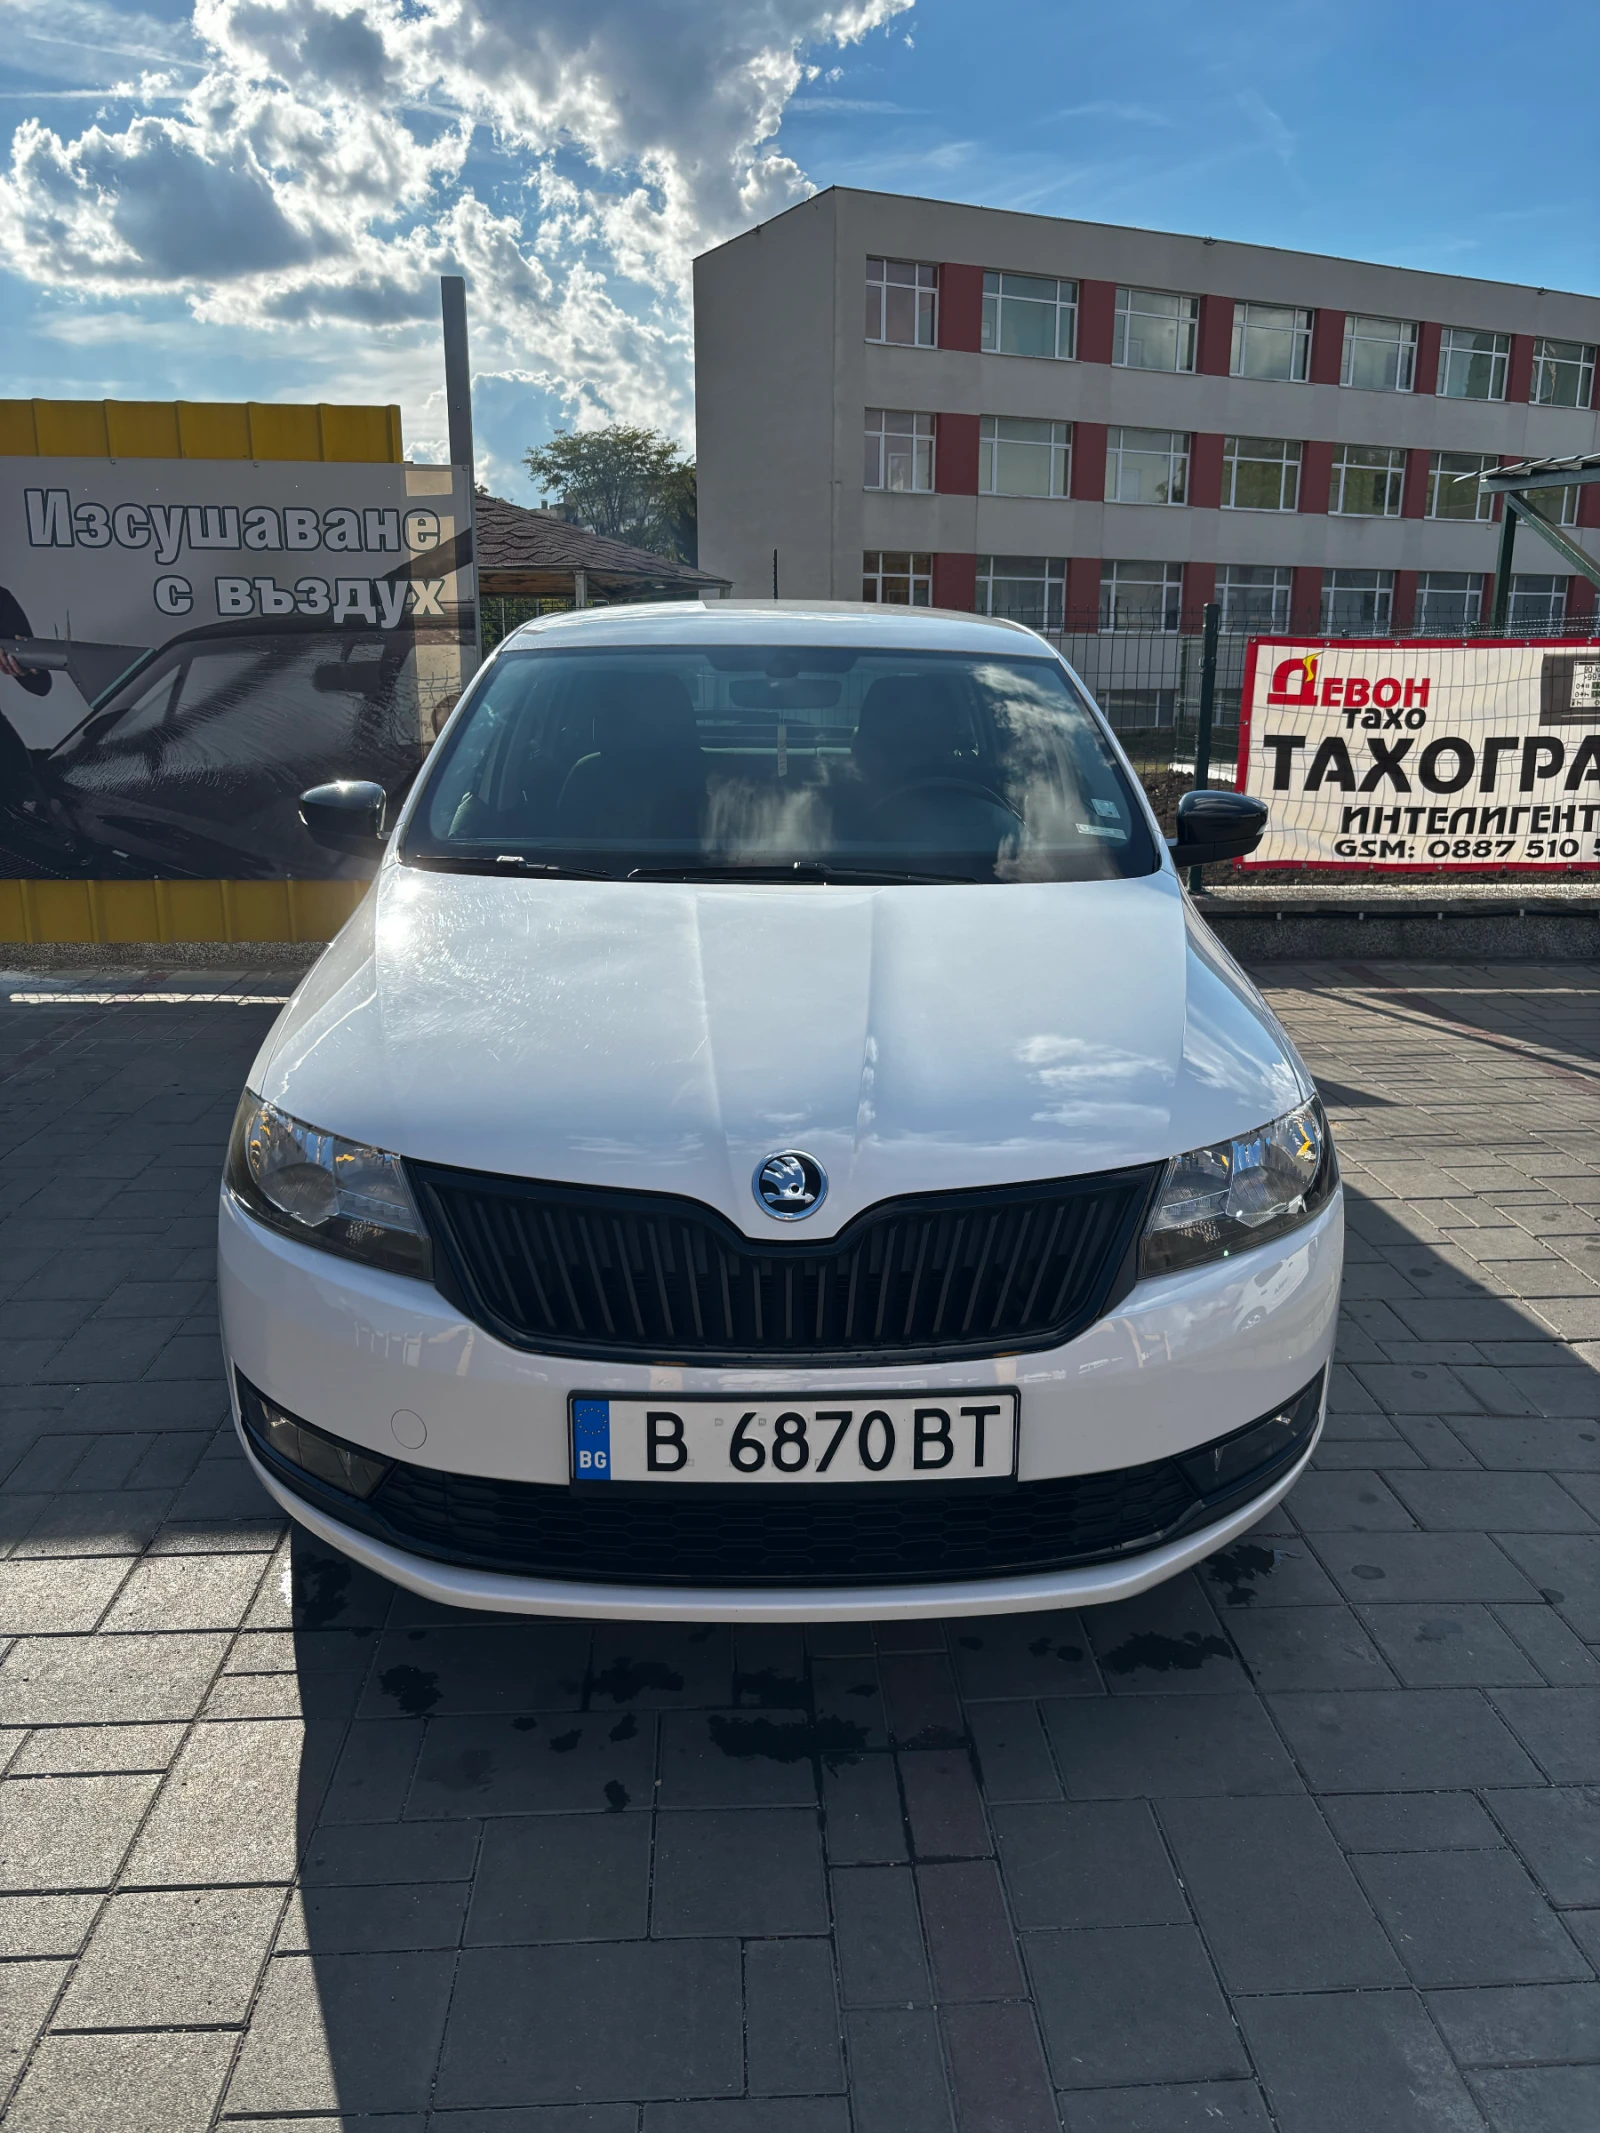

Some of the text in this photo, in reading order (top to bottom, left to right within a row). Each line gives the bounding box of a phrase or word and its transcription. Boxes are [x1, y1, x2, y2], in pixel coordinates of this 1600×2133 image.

[24, 488, 441, 565] Изсушаване
[153, 575, 446, 629] с въздух
[1267, 655, 1430, 707] ДЕВОН
[1263, 734, 1600, 795] ТАХОГРА
[1340, 805, 1600, 835] ИНТЕЛИГЕНТ
[1334, 839, 1415, 859] GSM:
[1427, 839, 1516, 859] 0887
[1525, 838, 1580, 858] 510
[579, 1450, 607, 1469] BG
[646, 1405, 1001, 1473] B 6870 BT
